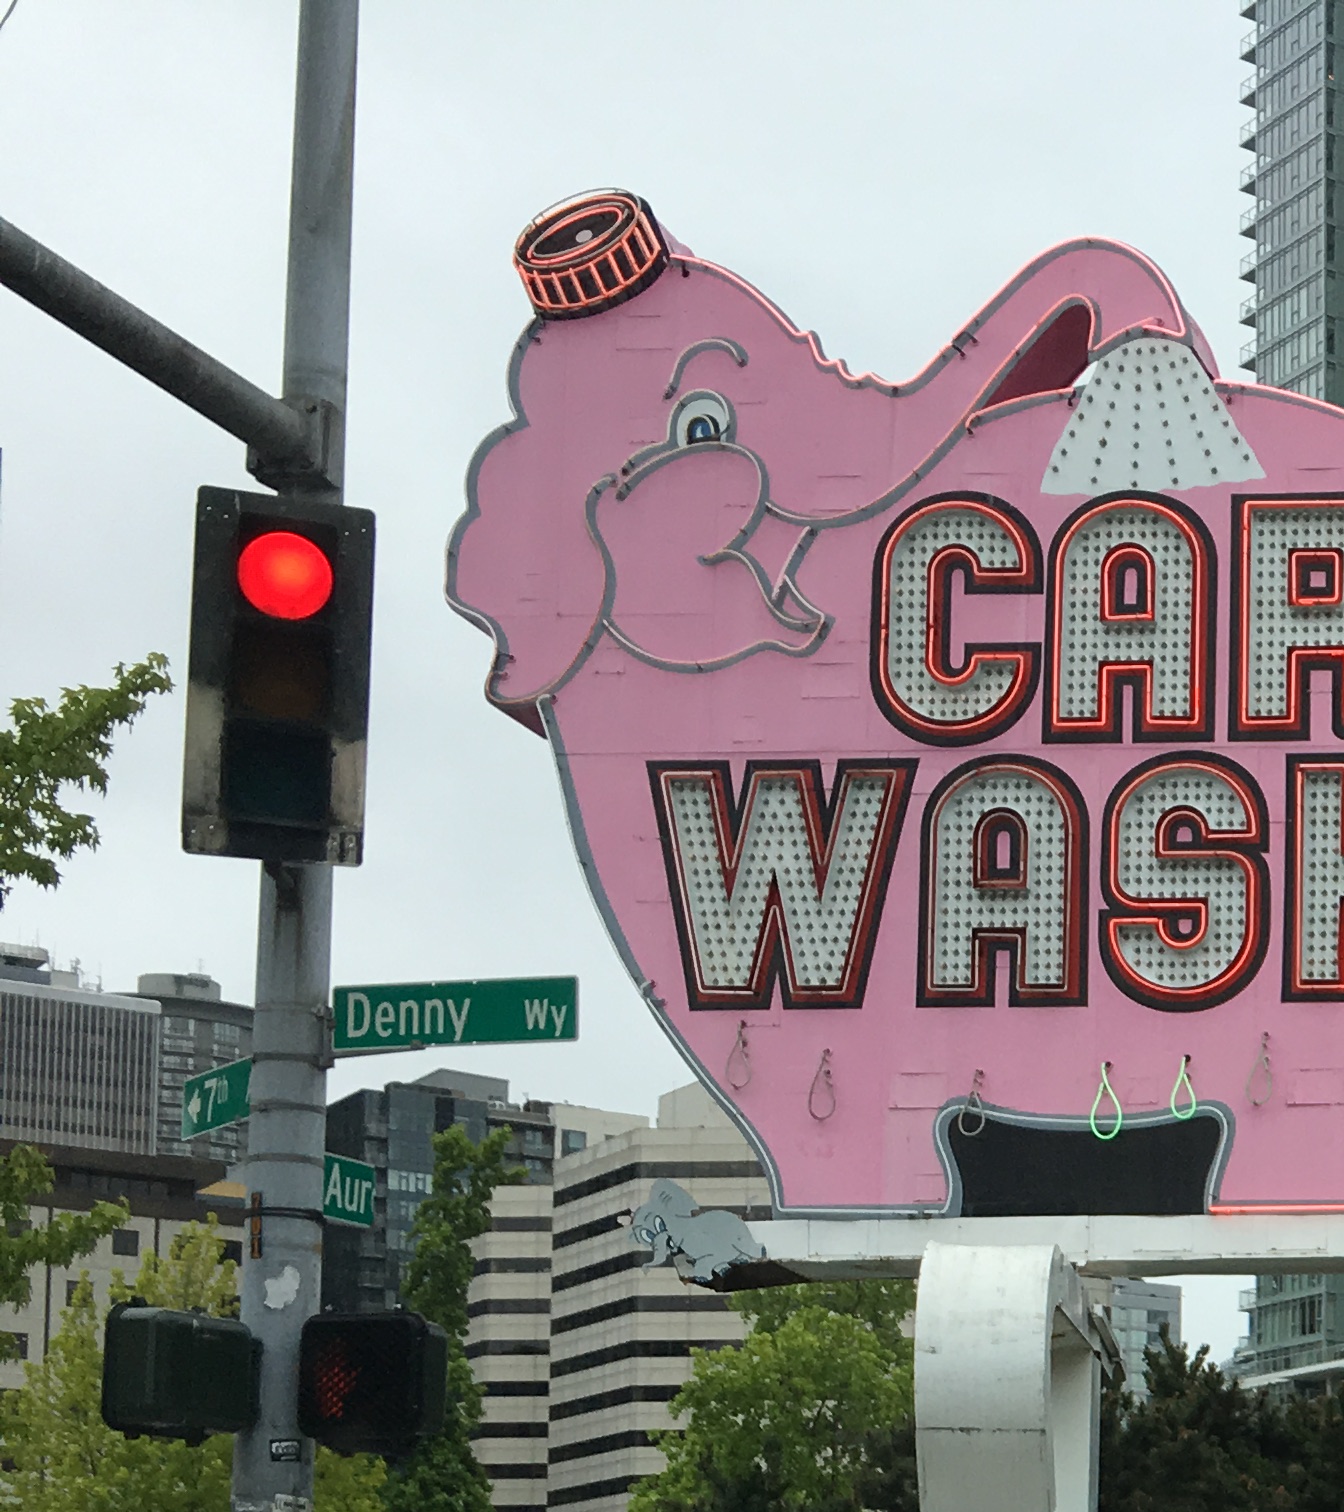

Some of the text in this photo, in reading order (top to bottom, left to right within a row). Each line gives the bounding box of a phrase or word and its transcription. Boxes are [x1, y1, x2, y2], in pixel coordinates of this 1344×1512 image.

[346, 992, 567, 1041] Denny Wy
[203, 1074, 229, 1123] 7th
